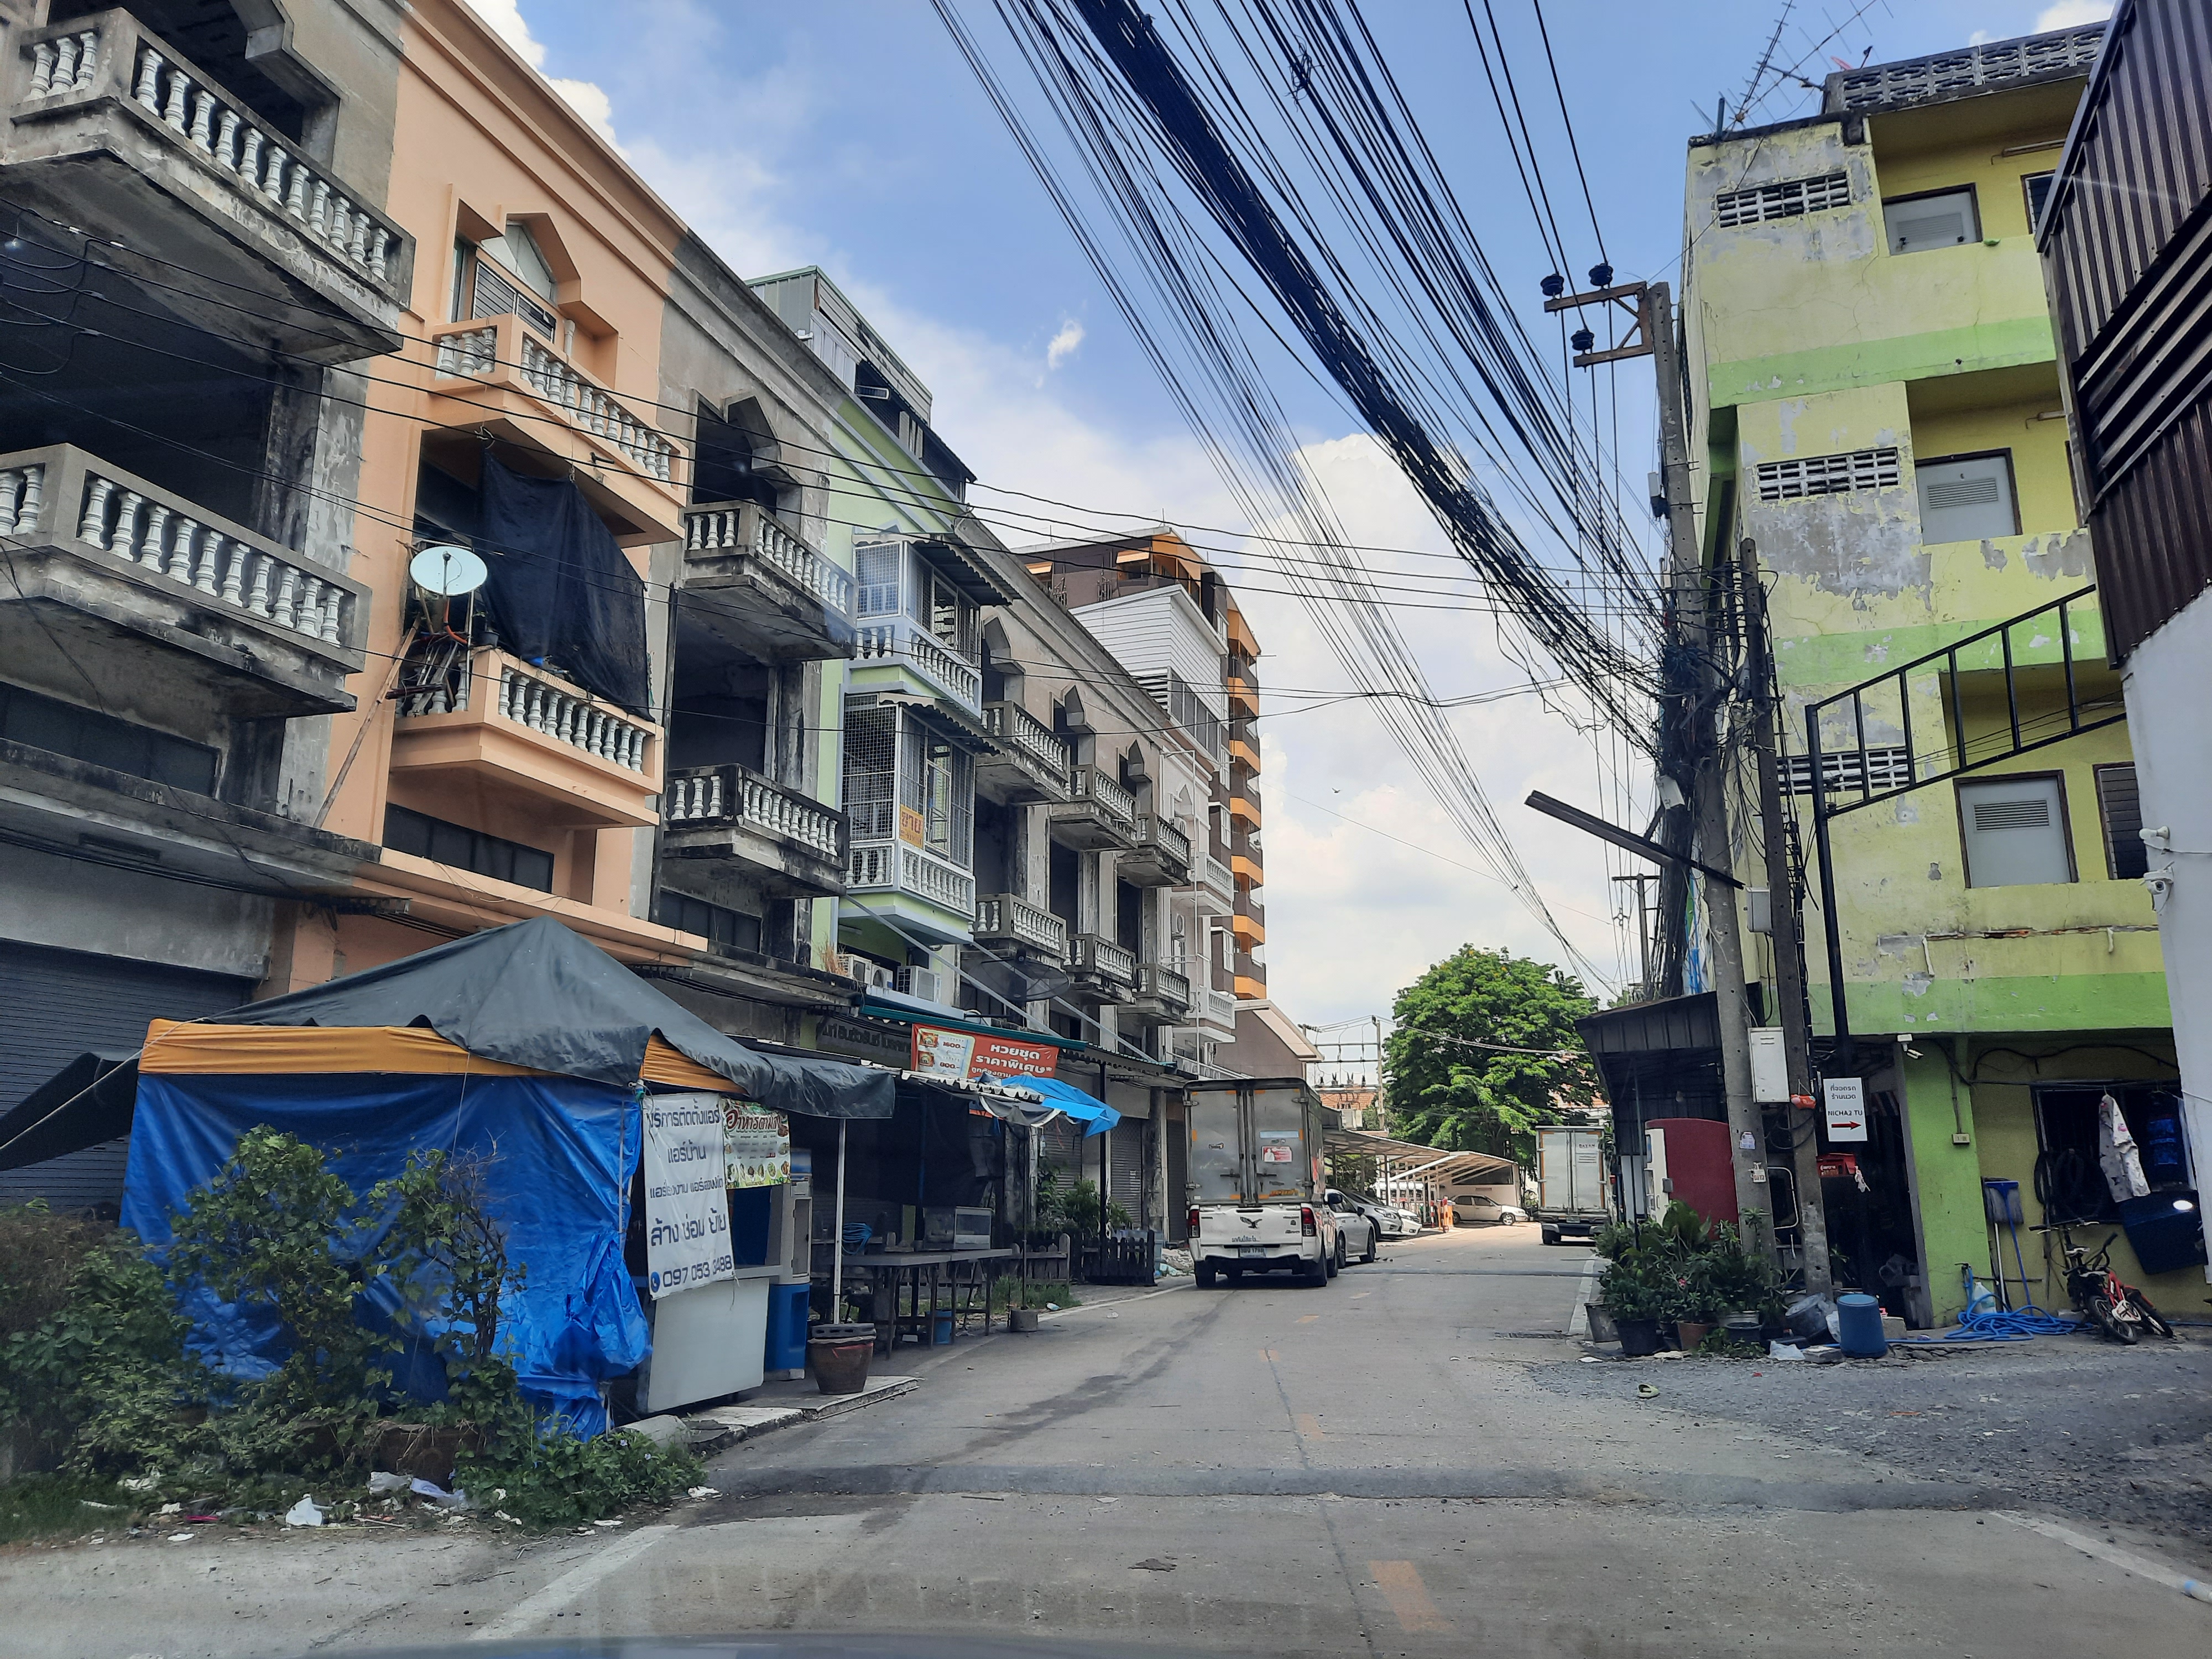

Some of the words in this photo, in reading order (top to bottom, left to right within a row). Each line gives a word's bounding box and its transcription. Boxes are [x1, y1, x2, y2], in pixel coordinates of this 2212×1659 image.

[990, 1044, 1040, 1061] หวยชุด
[667, 1139, 707, 1163] แอร์บ้าน
[651, 1217, 680, 1246] ล้าง
[681, 1213, 705, 1240] ซ่อม
[663, 1266, 688, 1287] 097
[691, 1261, 710, 1281] 053
[713, 1255, 732, 1275] 3488
